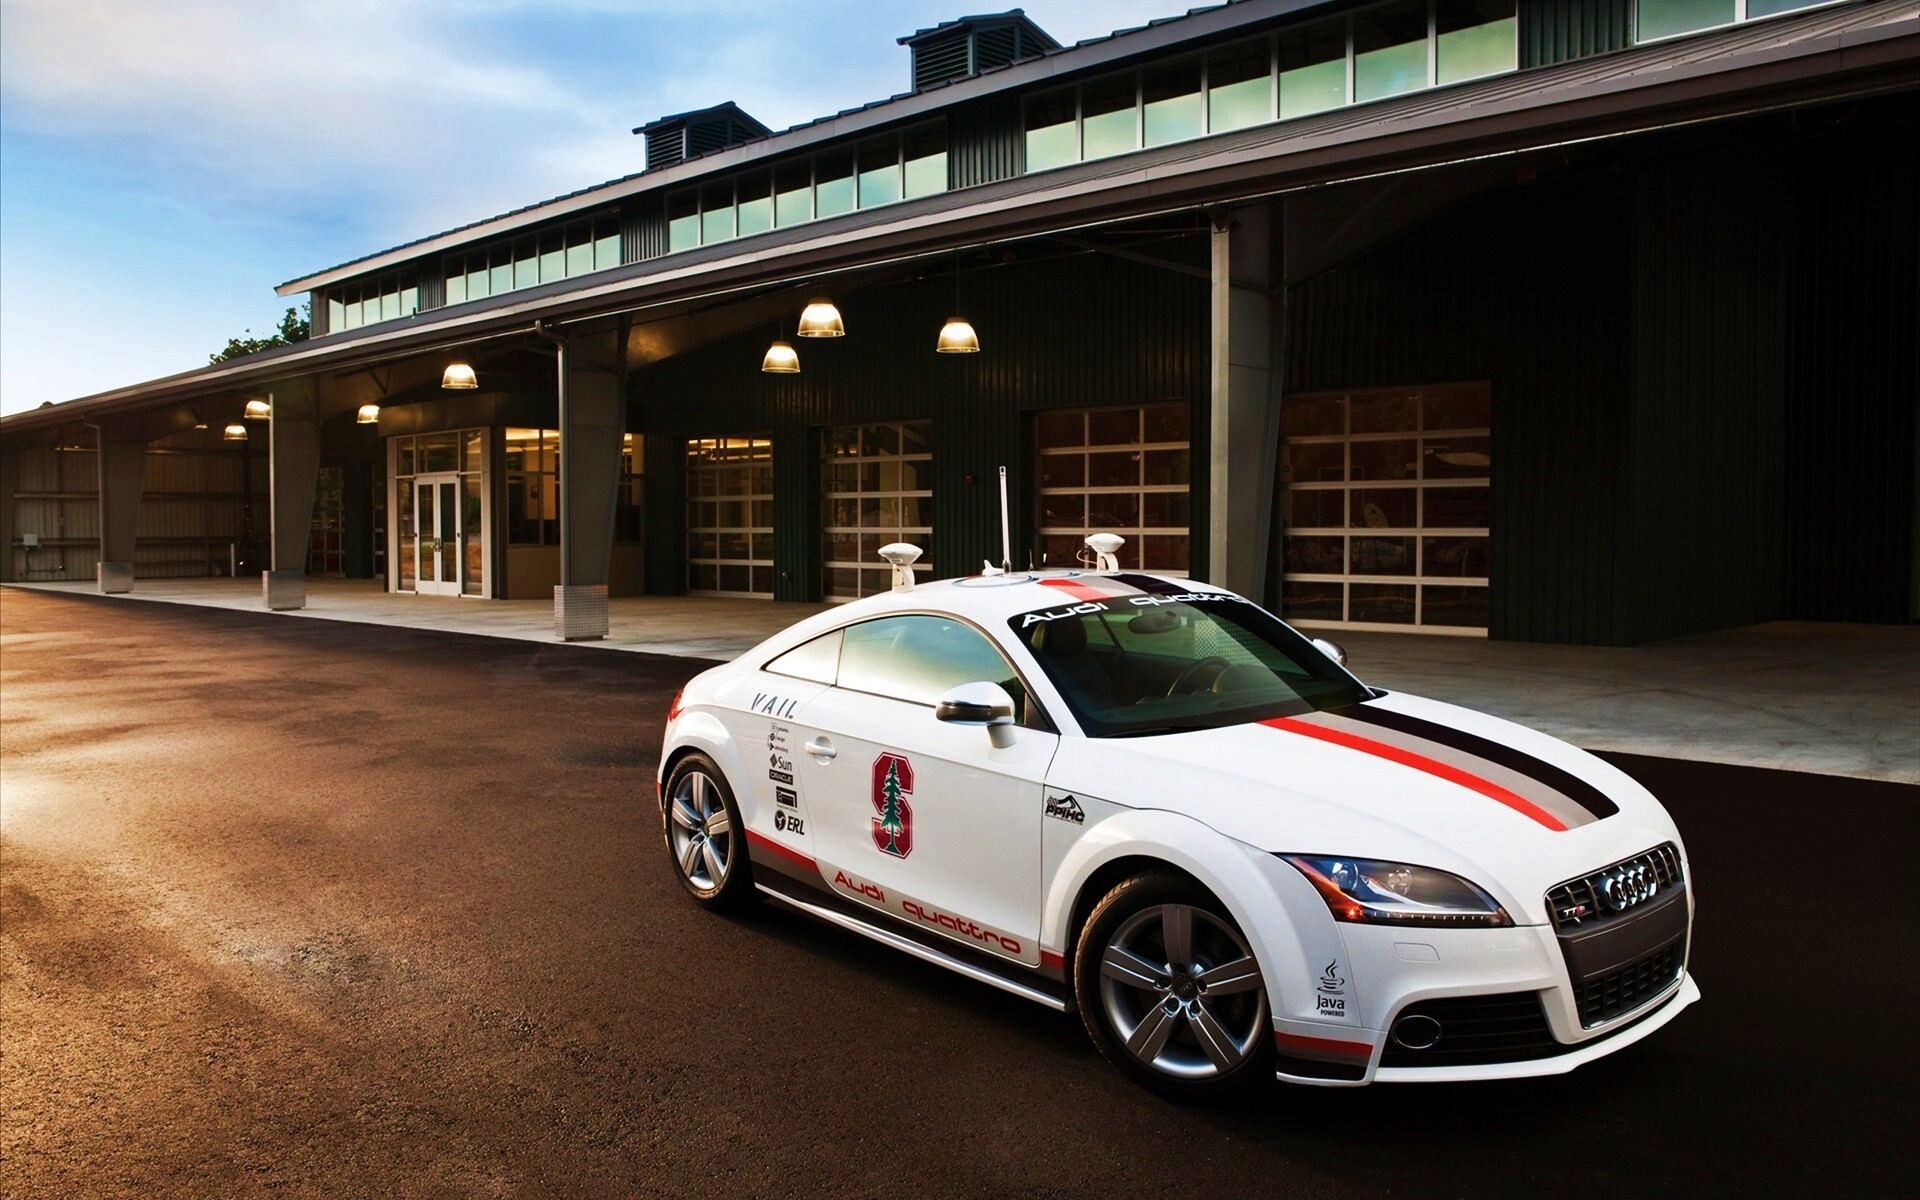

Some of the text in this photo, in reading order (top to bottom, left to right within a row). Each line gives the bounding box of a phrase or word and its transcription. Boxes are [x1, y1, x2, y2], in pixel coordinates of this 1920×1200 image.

[1021, 602, 1109, 628] Audi
[751, 692, 798, 719] VAIL
[777, 756, 793, 772] Sun
[770, 771, 793, 783] ORACLE
[1045, 803, 1086, 823] PPIHC
[786, 815, 805, 836] ERL
[834, 871, 1021, 954] Audi quattro
[1316, 994, 1345, 1010] Java
[1320, 1009, 1345, 1018] POWERED
